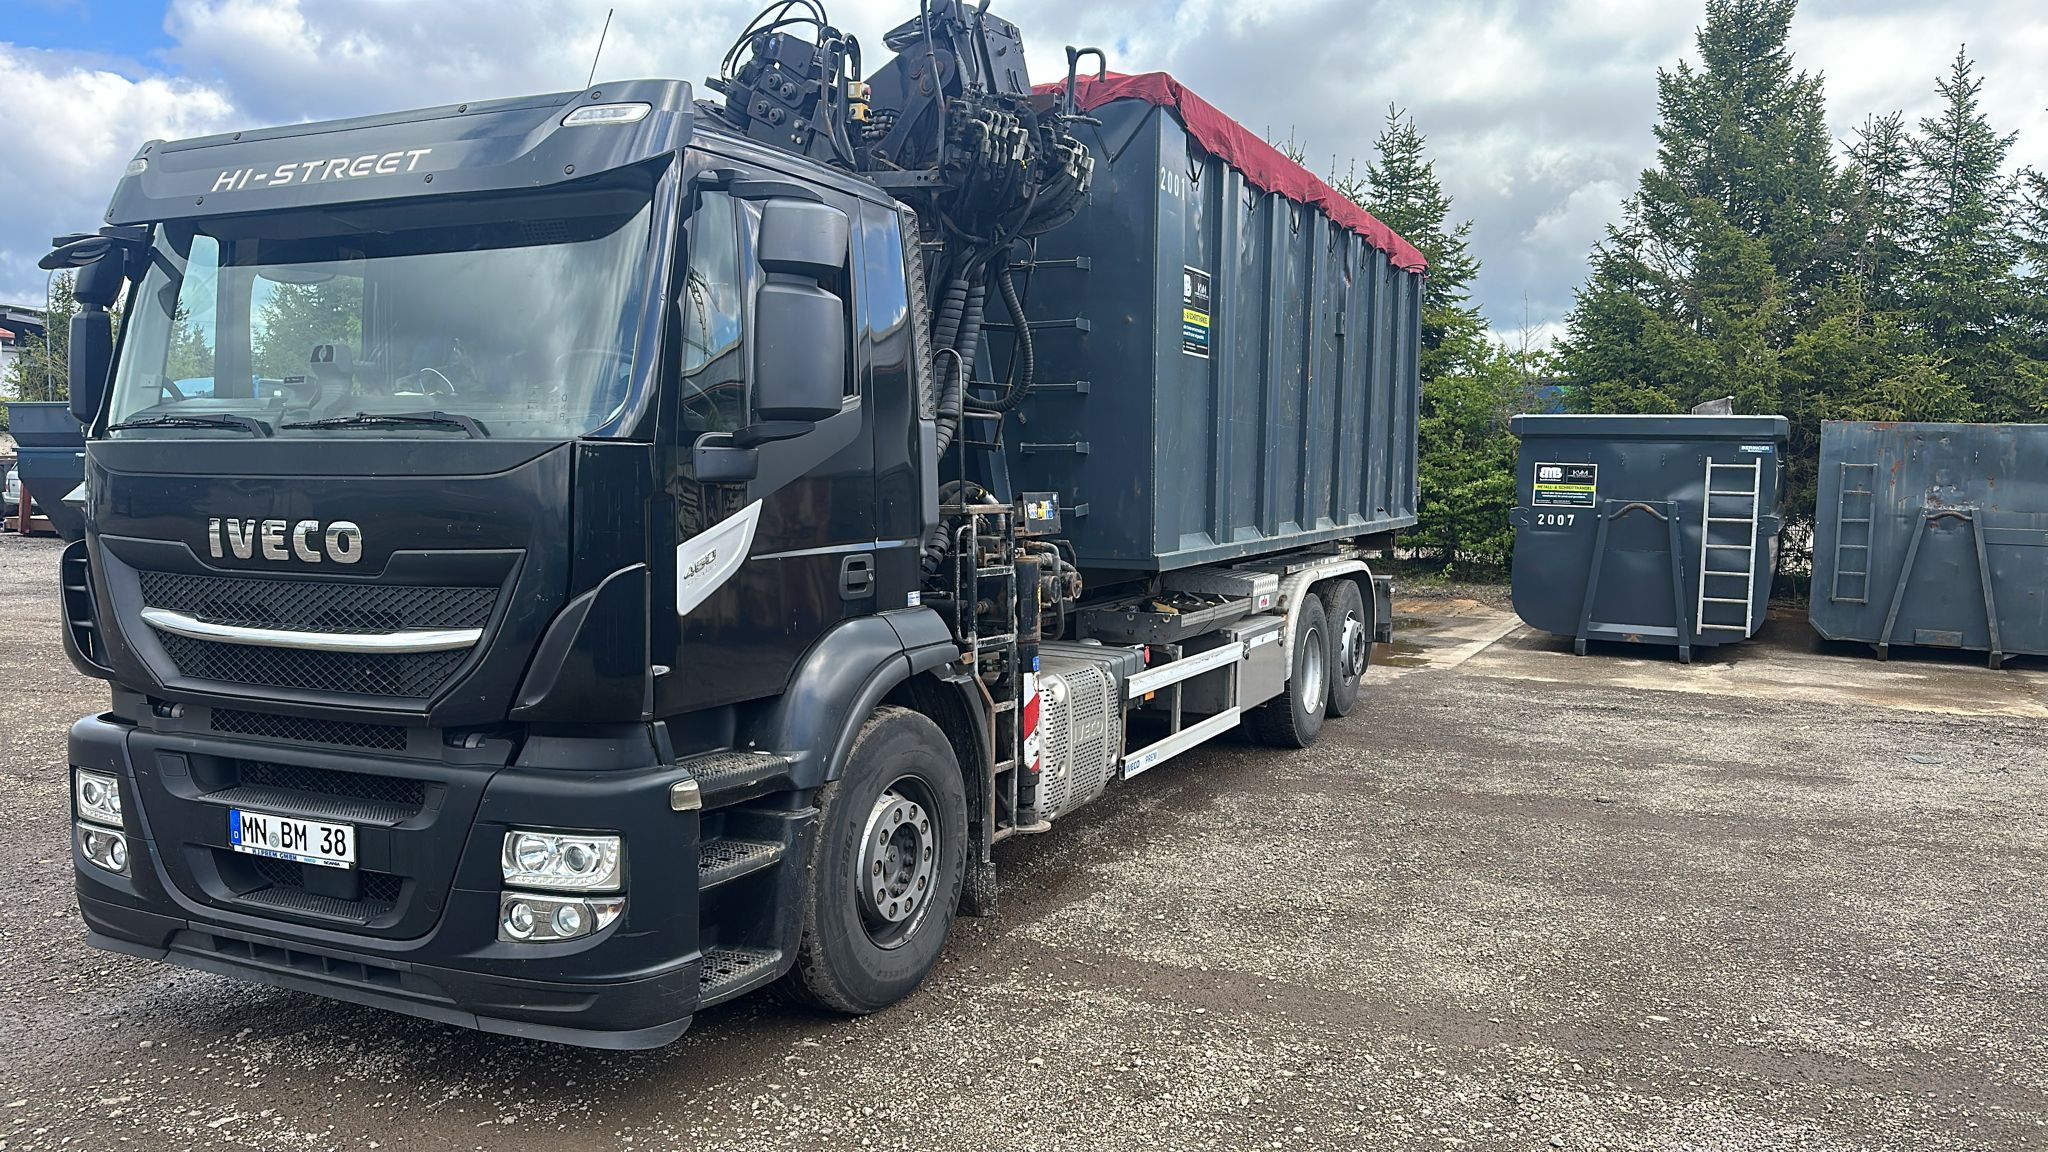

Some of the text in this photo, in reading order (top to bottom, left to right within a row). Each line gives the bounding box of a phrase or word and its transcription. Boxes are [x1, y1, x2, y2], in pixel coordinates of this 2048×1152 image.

[211, 149, 432, 192] HI-STREET
[1160, 166, 1185, 201] 2001
[208, 517, 362, 564] IVECO
[1537, 513, 1575, 526] 2007
[241, 815, 347, 857] MN BM 38
